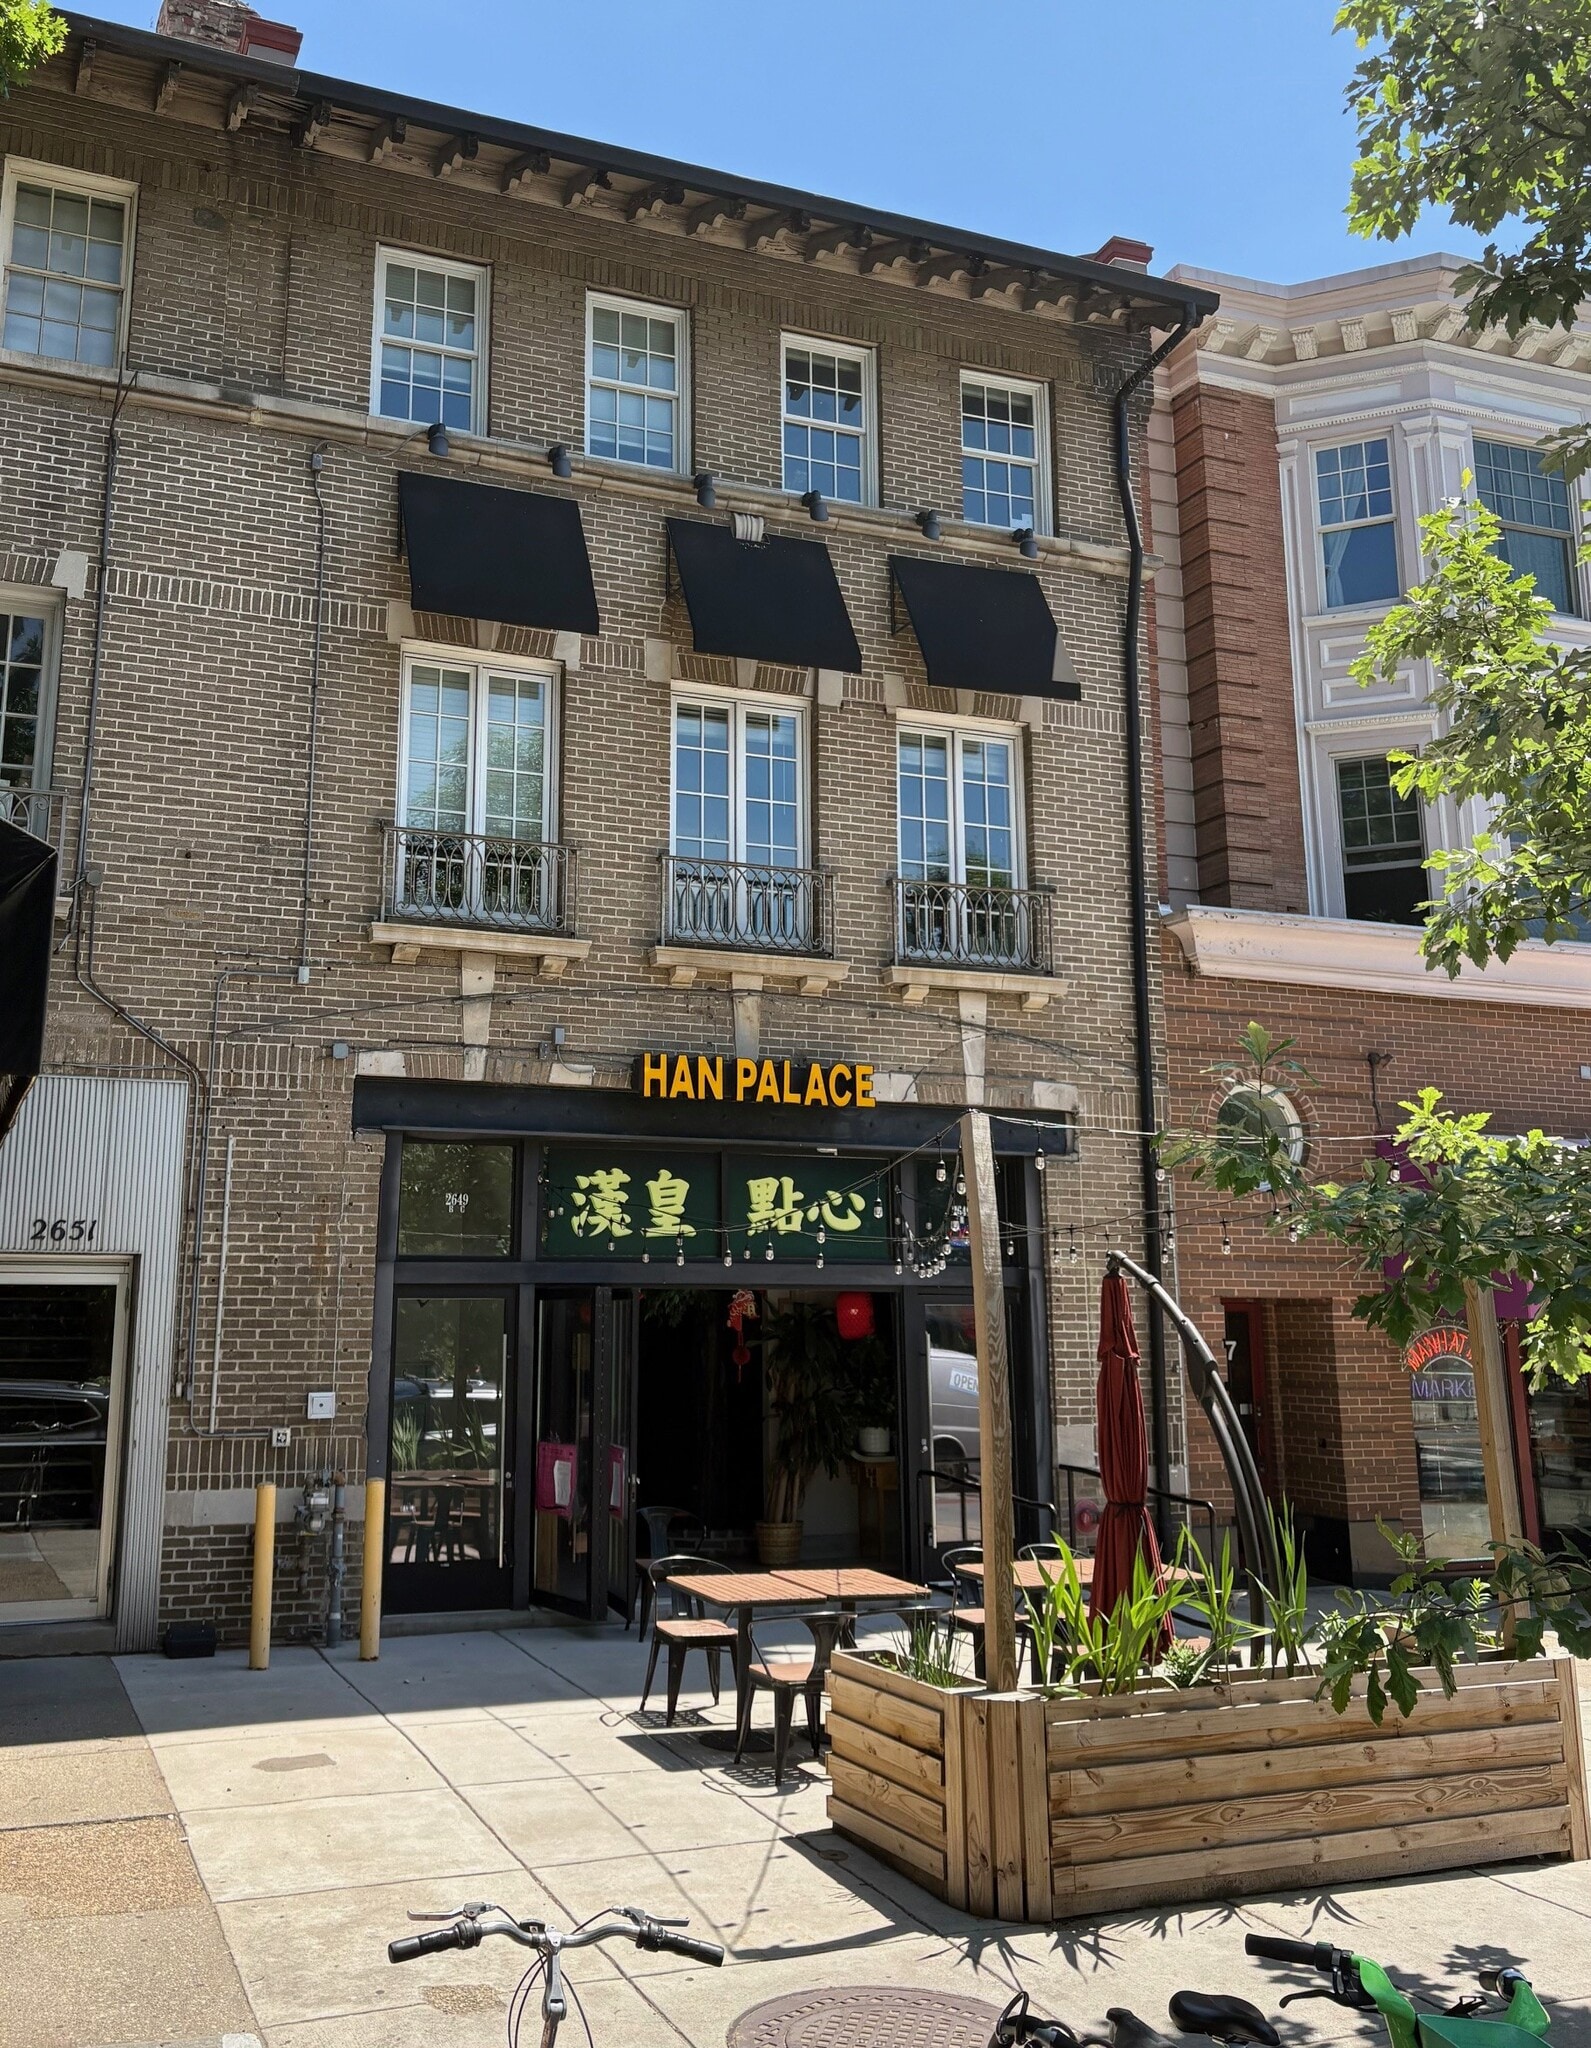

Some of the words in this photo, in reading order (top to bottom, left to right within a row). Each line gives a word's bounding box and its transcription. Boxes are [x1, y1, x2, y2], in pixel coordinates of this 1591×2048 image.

[643, 1053, 724, 1100] HAN
[736, 1057, 877, 1108] PALACE
[445, 1193, 469, 1206] 2649
[571, 1168, 697, 1237] 漢皇
[746, 1176, 866, 1236] 點心
[30, 1219, 97, 1241] 2651
[1224, 1340, 1237, 1361] 7
[1407, 1329, 1473, 1372] MANHAT
[1411, 1378, 1477, 1398] MARKE
